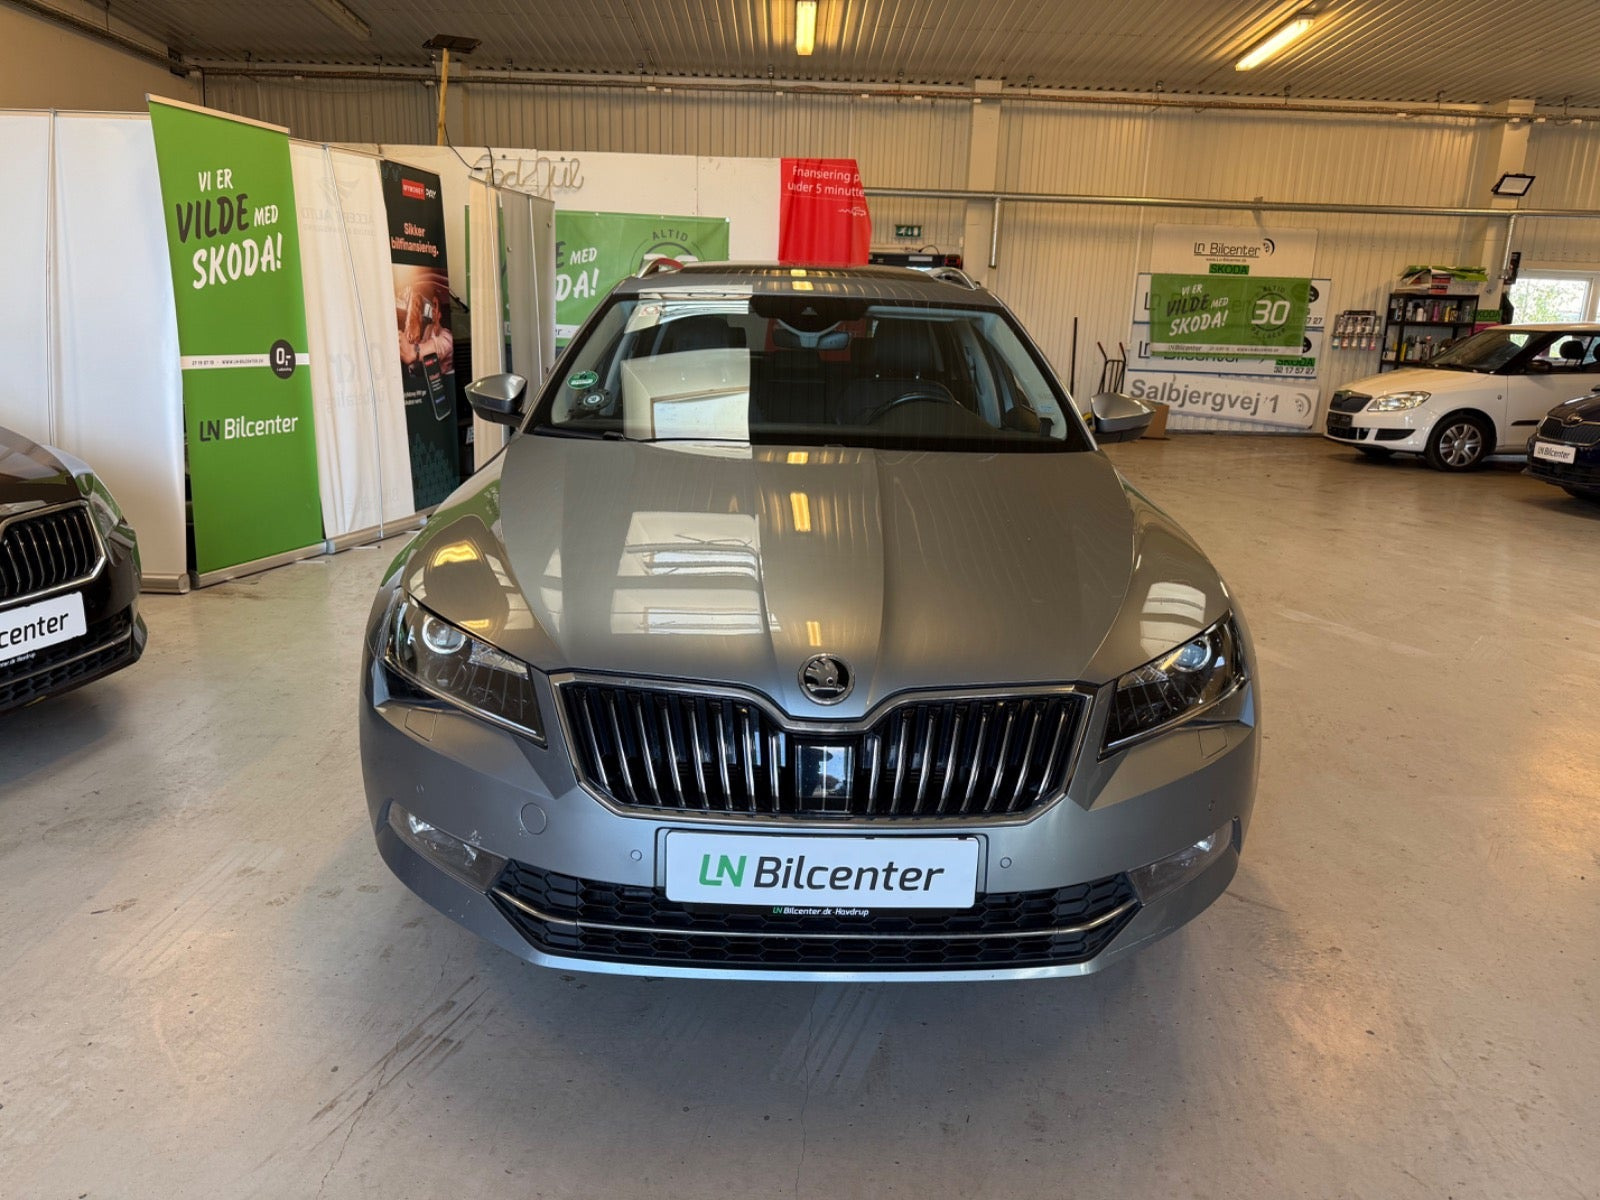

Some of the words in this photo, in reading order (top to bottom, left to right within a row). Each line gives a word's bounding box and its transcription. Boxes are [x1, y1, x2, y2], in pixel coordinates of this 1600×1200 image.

[198, 171, 211, 192] VI
[216, 168, 234, 189] ER
[792, 165, 851, 184] Fnansiering
[787, 181, 813, 192] uder
[816, 183, 822, 194] 5
[824, 185, 865, 198] minutte
[176, 193, 250, 244] VILDE
[254, 204, 278, 227] MED
[403, 222, 426, 237] Sikker
[652, 229, 689, 242] ALTID
[192, 232, 283, 290] SKODA!
[570, 247, 598, 265] MED
[1209, 242, 1261, 257] Bilcenter
[1210, 264, 1247, 274] SKODA
[556, 268, 599, 302] DA!
[1167, 293, 1210, 317] VILDE
[1251, 299, 1290, 325] 30
[1169, 309, 1229, 336] SKODA!
[1130, 379, 1261, 416] Salbjergvej
[1268, 395, 1280, 413] 1
[200, 419, 220, 442] LN
[224, 415, 298, 440] Bilcenter
[699, 854, 747, 888] LN
[754, 855, 945, 891] Bilcenter
